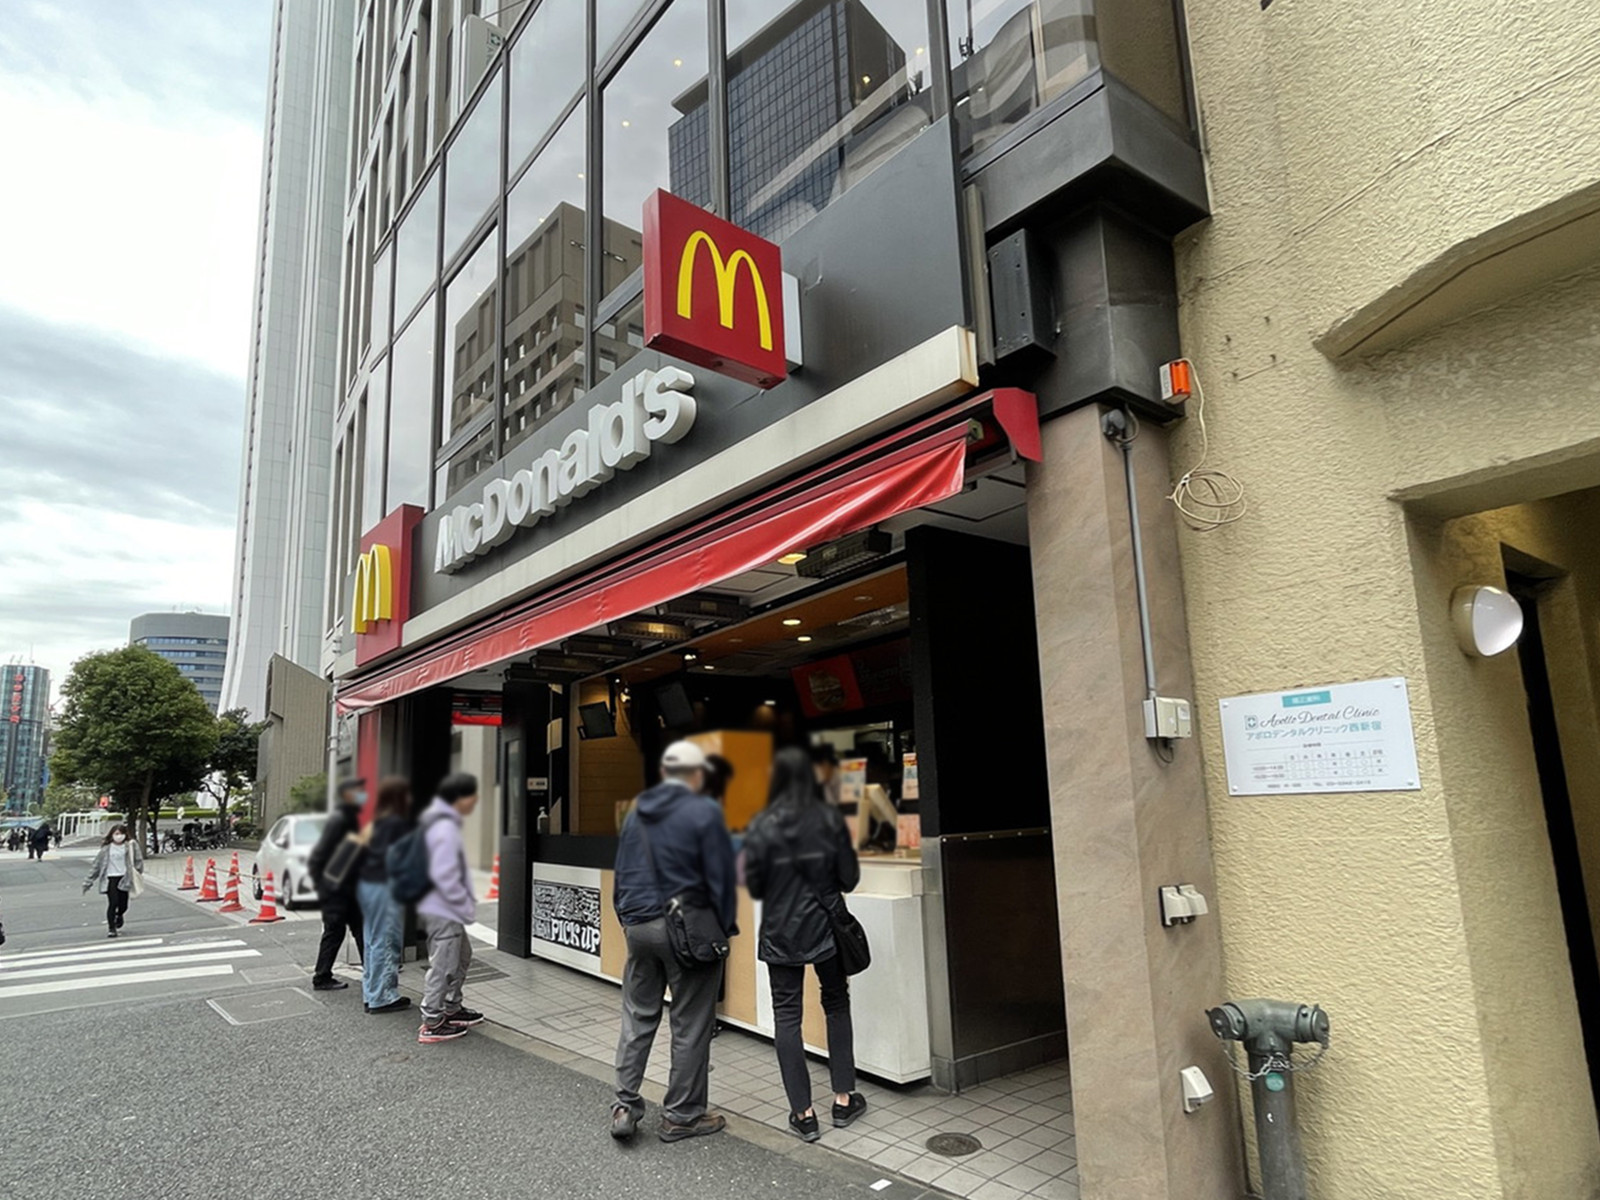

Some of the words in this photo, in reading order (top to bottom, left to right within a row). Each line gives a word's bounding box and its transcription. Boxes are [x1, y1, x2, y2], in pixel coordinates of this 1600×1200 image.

[434, 365, 697, 575] McDonald's
[1298, 710, 1342, 725] Dental
[1342, 705, 1380, 720] Clinic
[551, 918, 581, 948] PICK
[581, 924, 601, 953] UP
